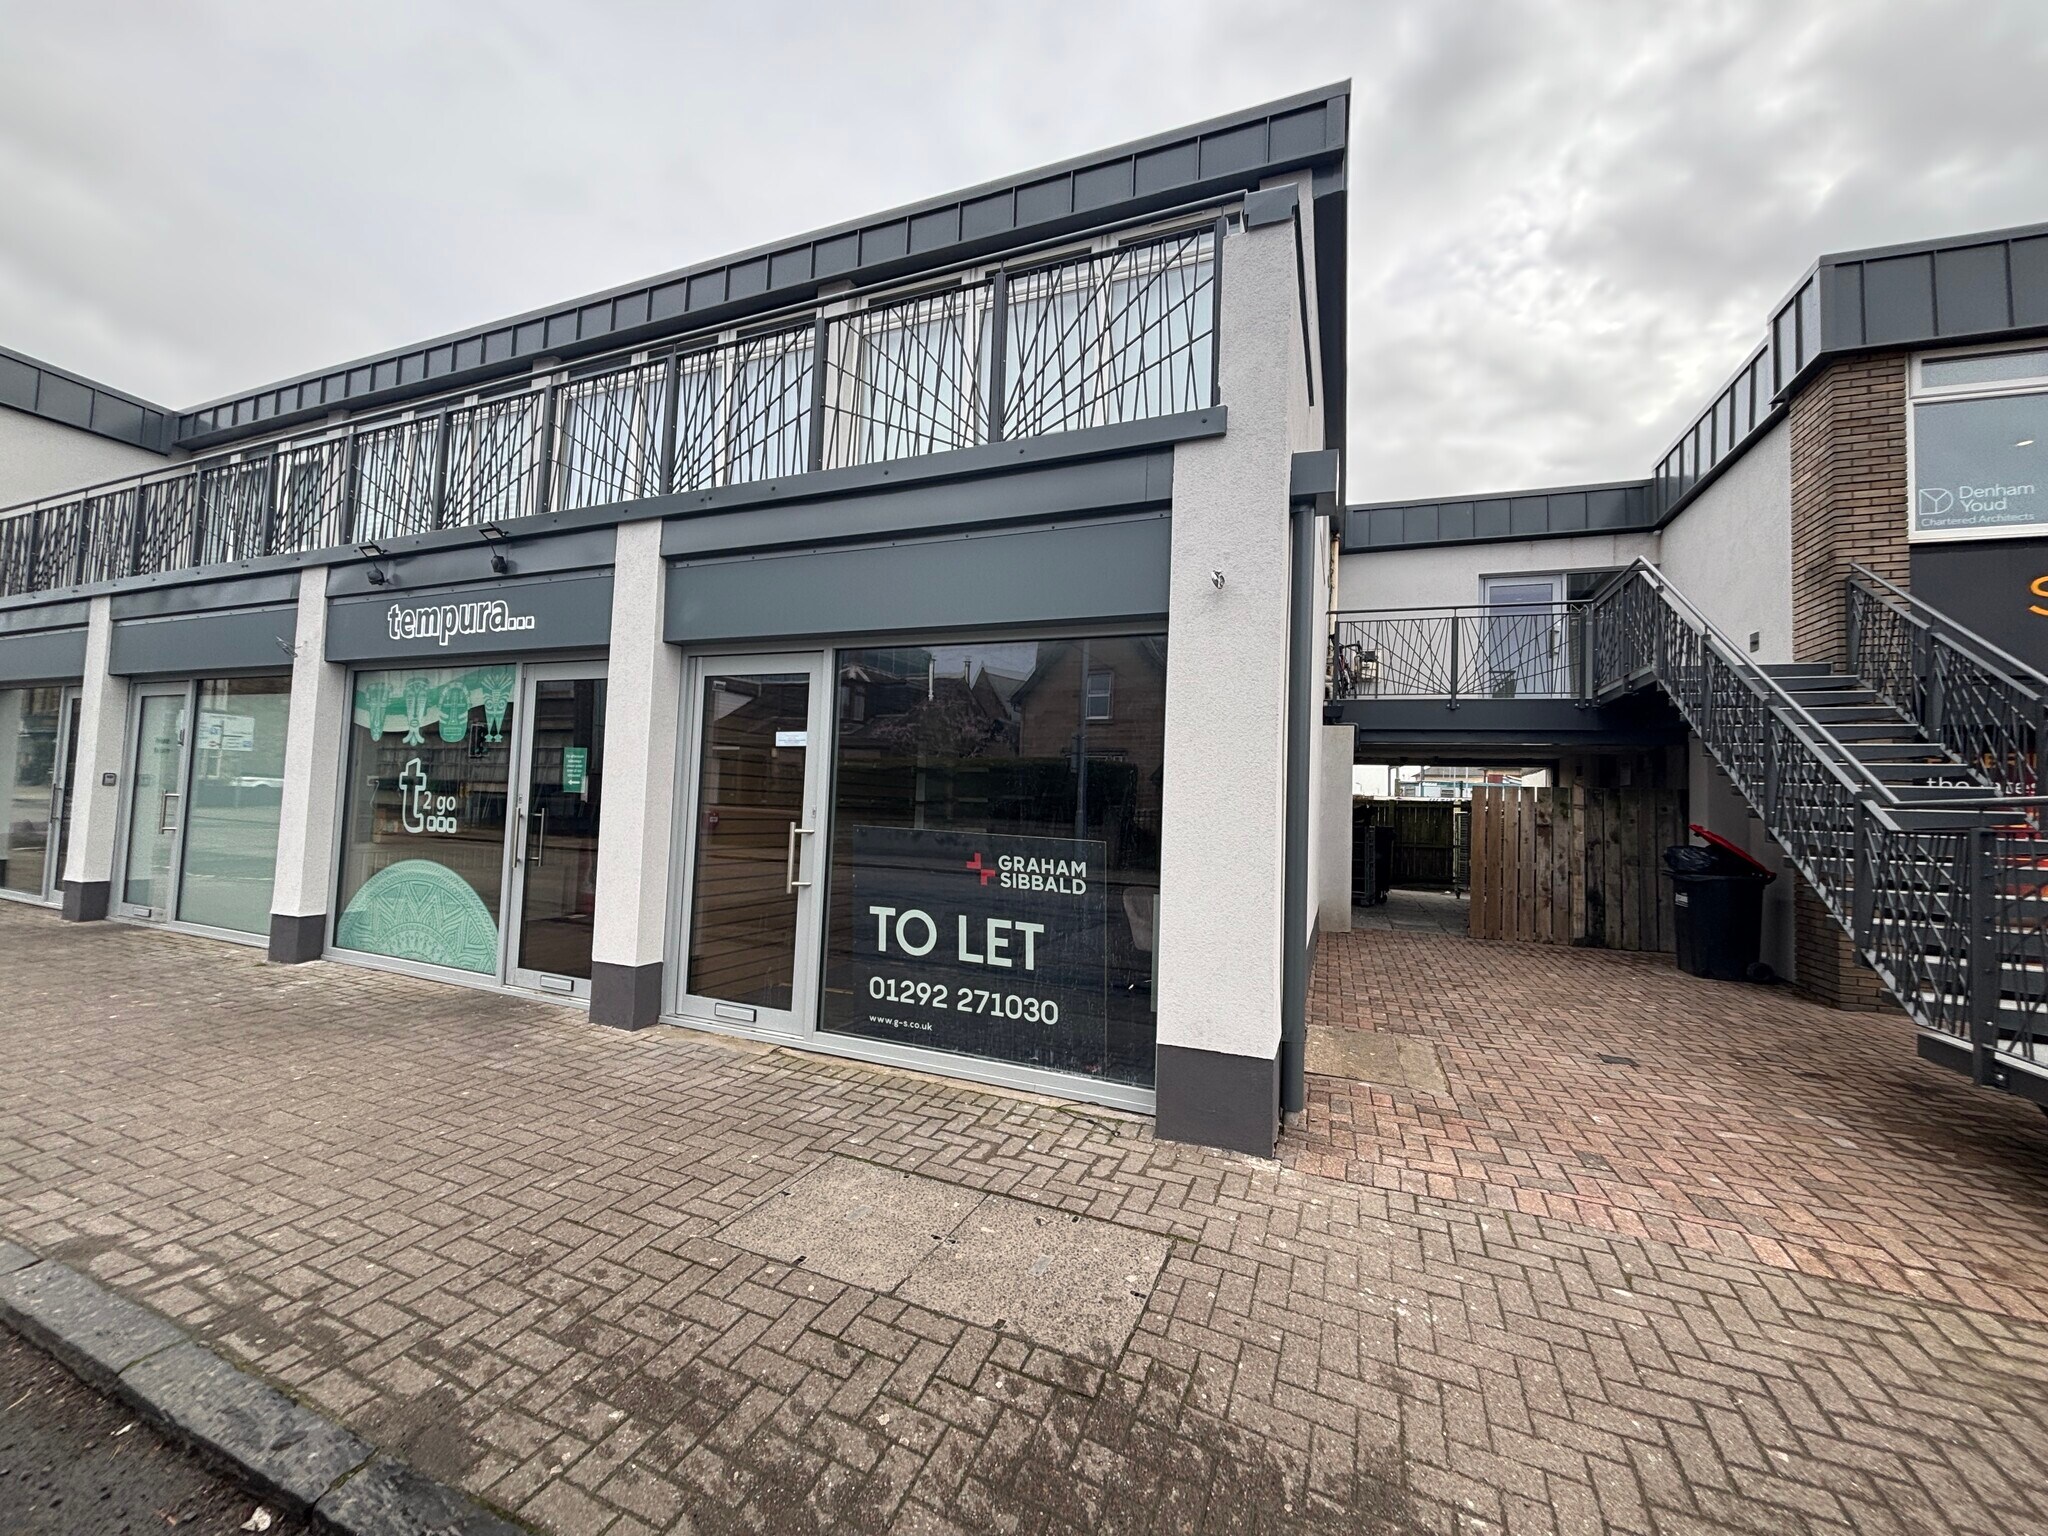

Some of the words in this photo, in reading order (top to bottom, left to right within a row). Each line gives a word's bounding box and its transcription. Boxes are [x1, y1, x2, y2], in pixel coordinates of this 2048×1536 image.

[1959, 484, 2035, 499] Denham
[1959, 497, 2008, 512] Youd
[1921, 515, 1977, 527] Chartered
[1979, 513, 2035, 523] Architects
[422, 790, 432, 810] 2
[436, 795, 457, 816] go
[998, 855, 1087, 878] GRAHAM
[1000, 872, 1087, 895] SIBBALD
[869, 905, 938, 957] TO
[958, 914, 1045, 971] LET
[869, 976, 948, 1009] 01292
[957, 987, 1059, 1025] 271030
[869, 1015, 933, 1031] www.g-s.co.uk
